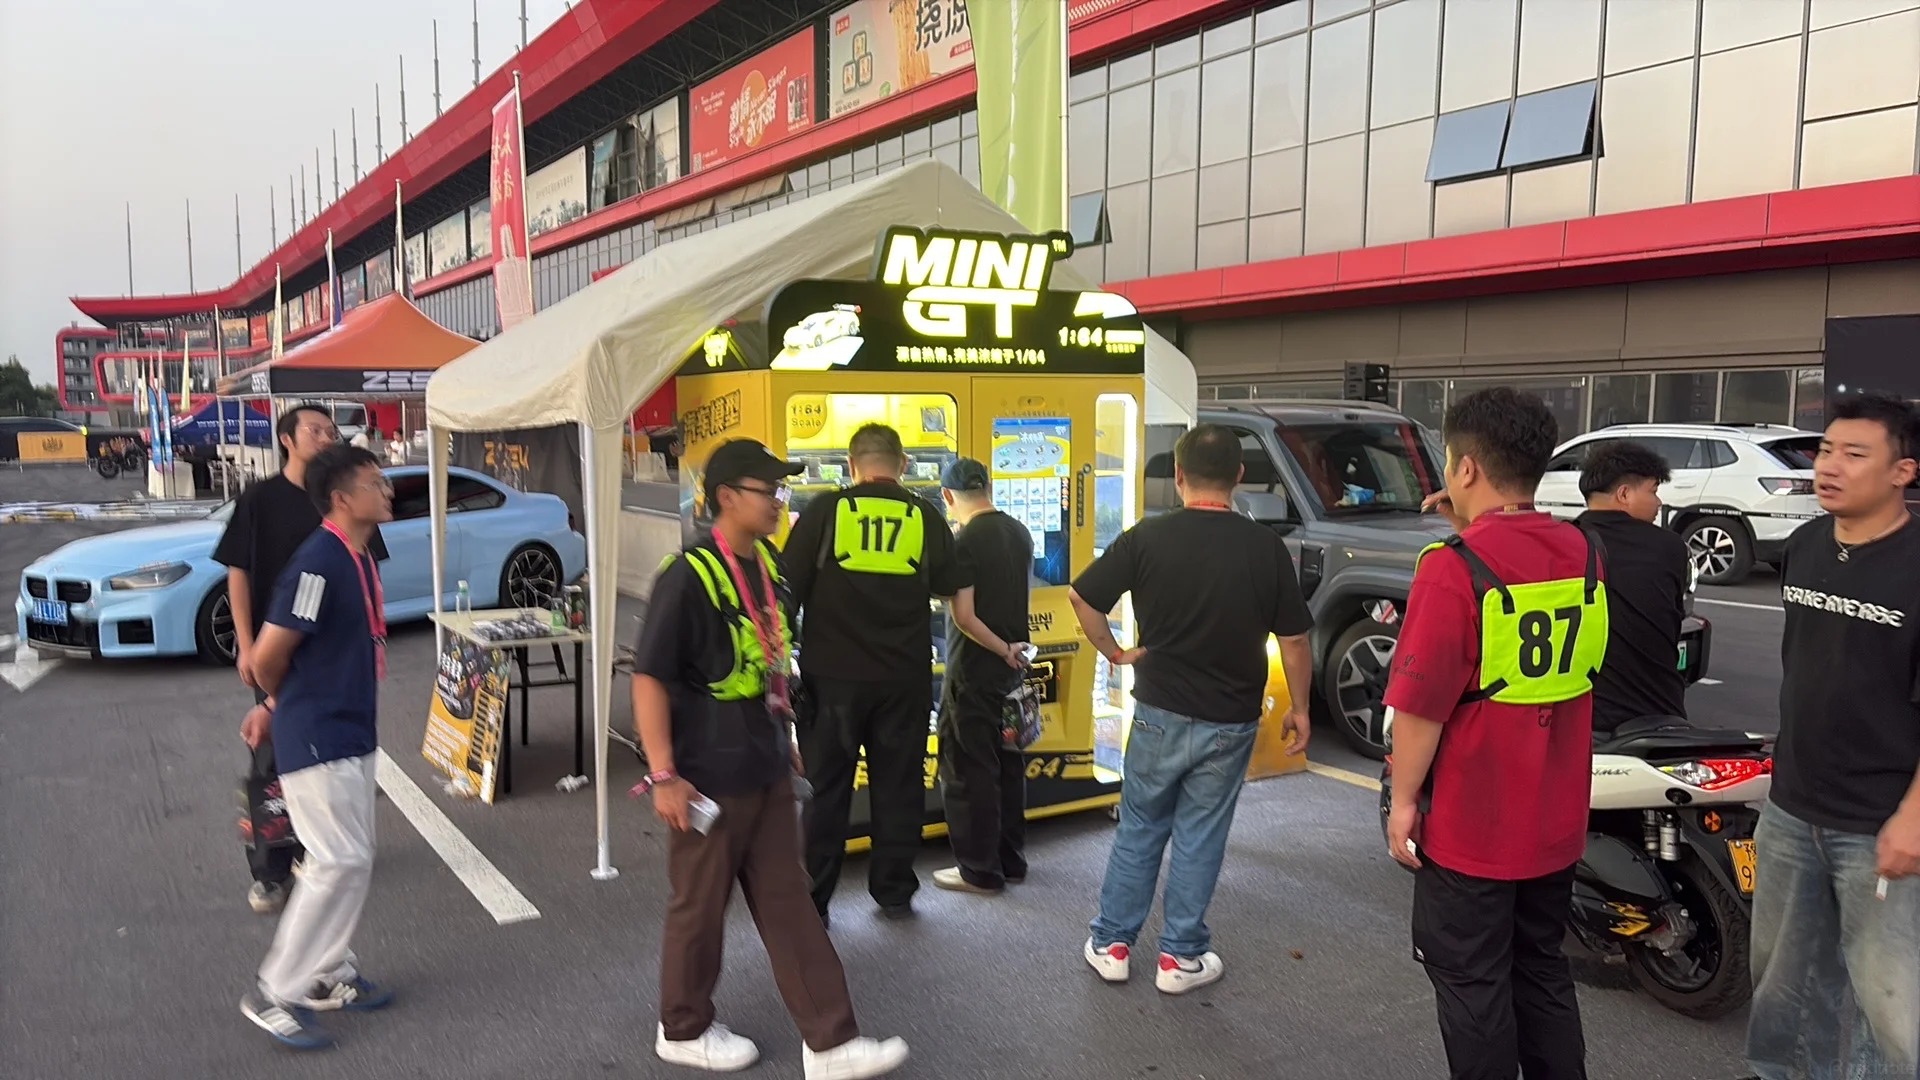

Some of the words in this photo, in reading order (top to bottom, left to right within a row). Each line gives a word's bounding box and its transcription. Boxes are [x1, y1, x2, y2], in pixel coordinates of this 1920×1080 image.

[882, 234, 1050, 291] MINI
[902, 286, 1039, 339] GT
[1058, 326, 1103, 347] 1:64
[791, 403, 822, 415] 1:64
[791, 417, 822, 427] Scale
[857, 515, 903, 553] 117
[1518, 604, 1582, 678] 87
